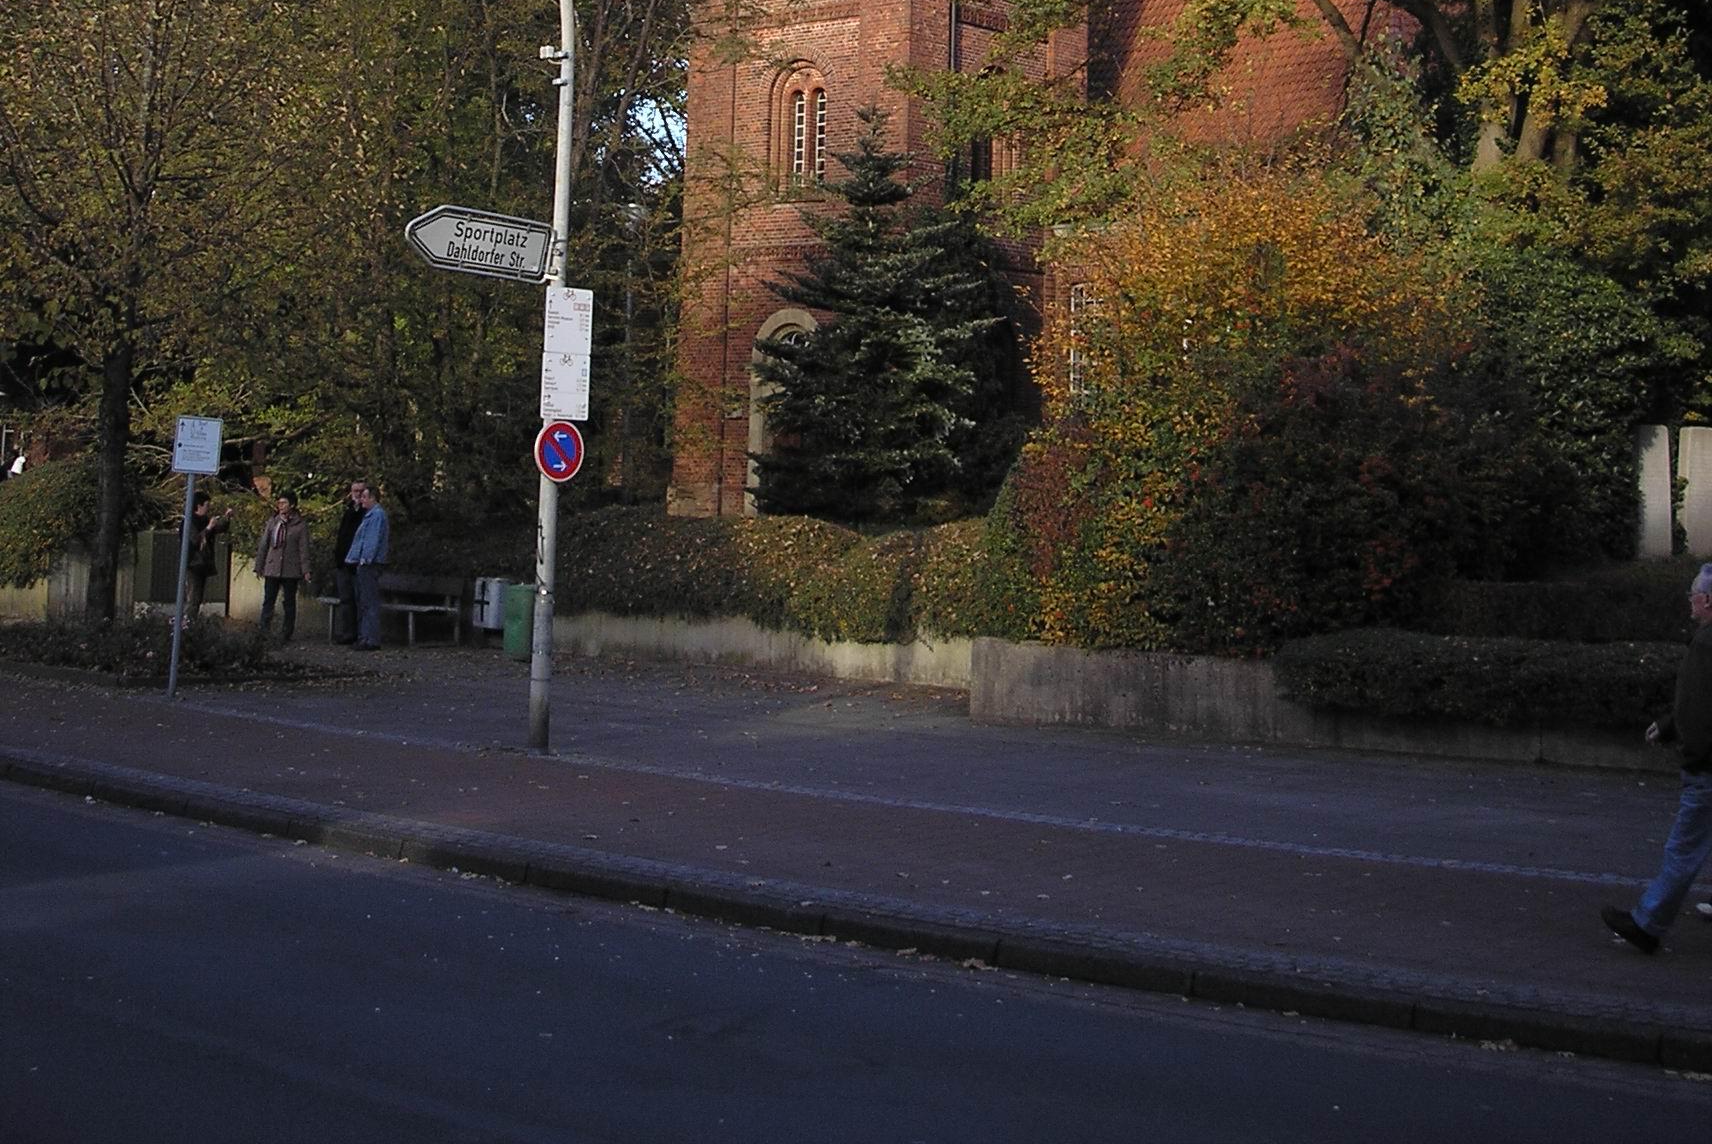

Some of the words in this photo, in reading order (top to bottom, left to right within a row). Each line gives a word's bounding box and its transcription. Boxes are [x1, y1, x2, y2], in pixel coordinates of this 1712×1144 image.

[454, 221, 528, 248] Sportplatz
[446, 241, 505, 265] Dahldorfer
[508, 251, 525, 268] Str.
